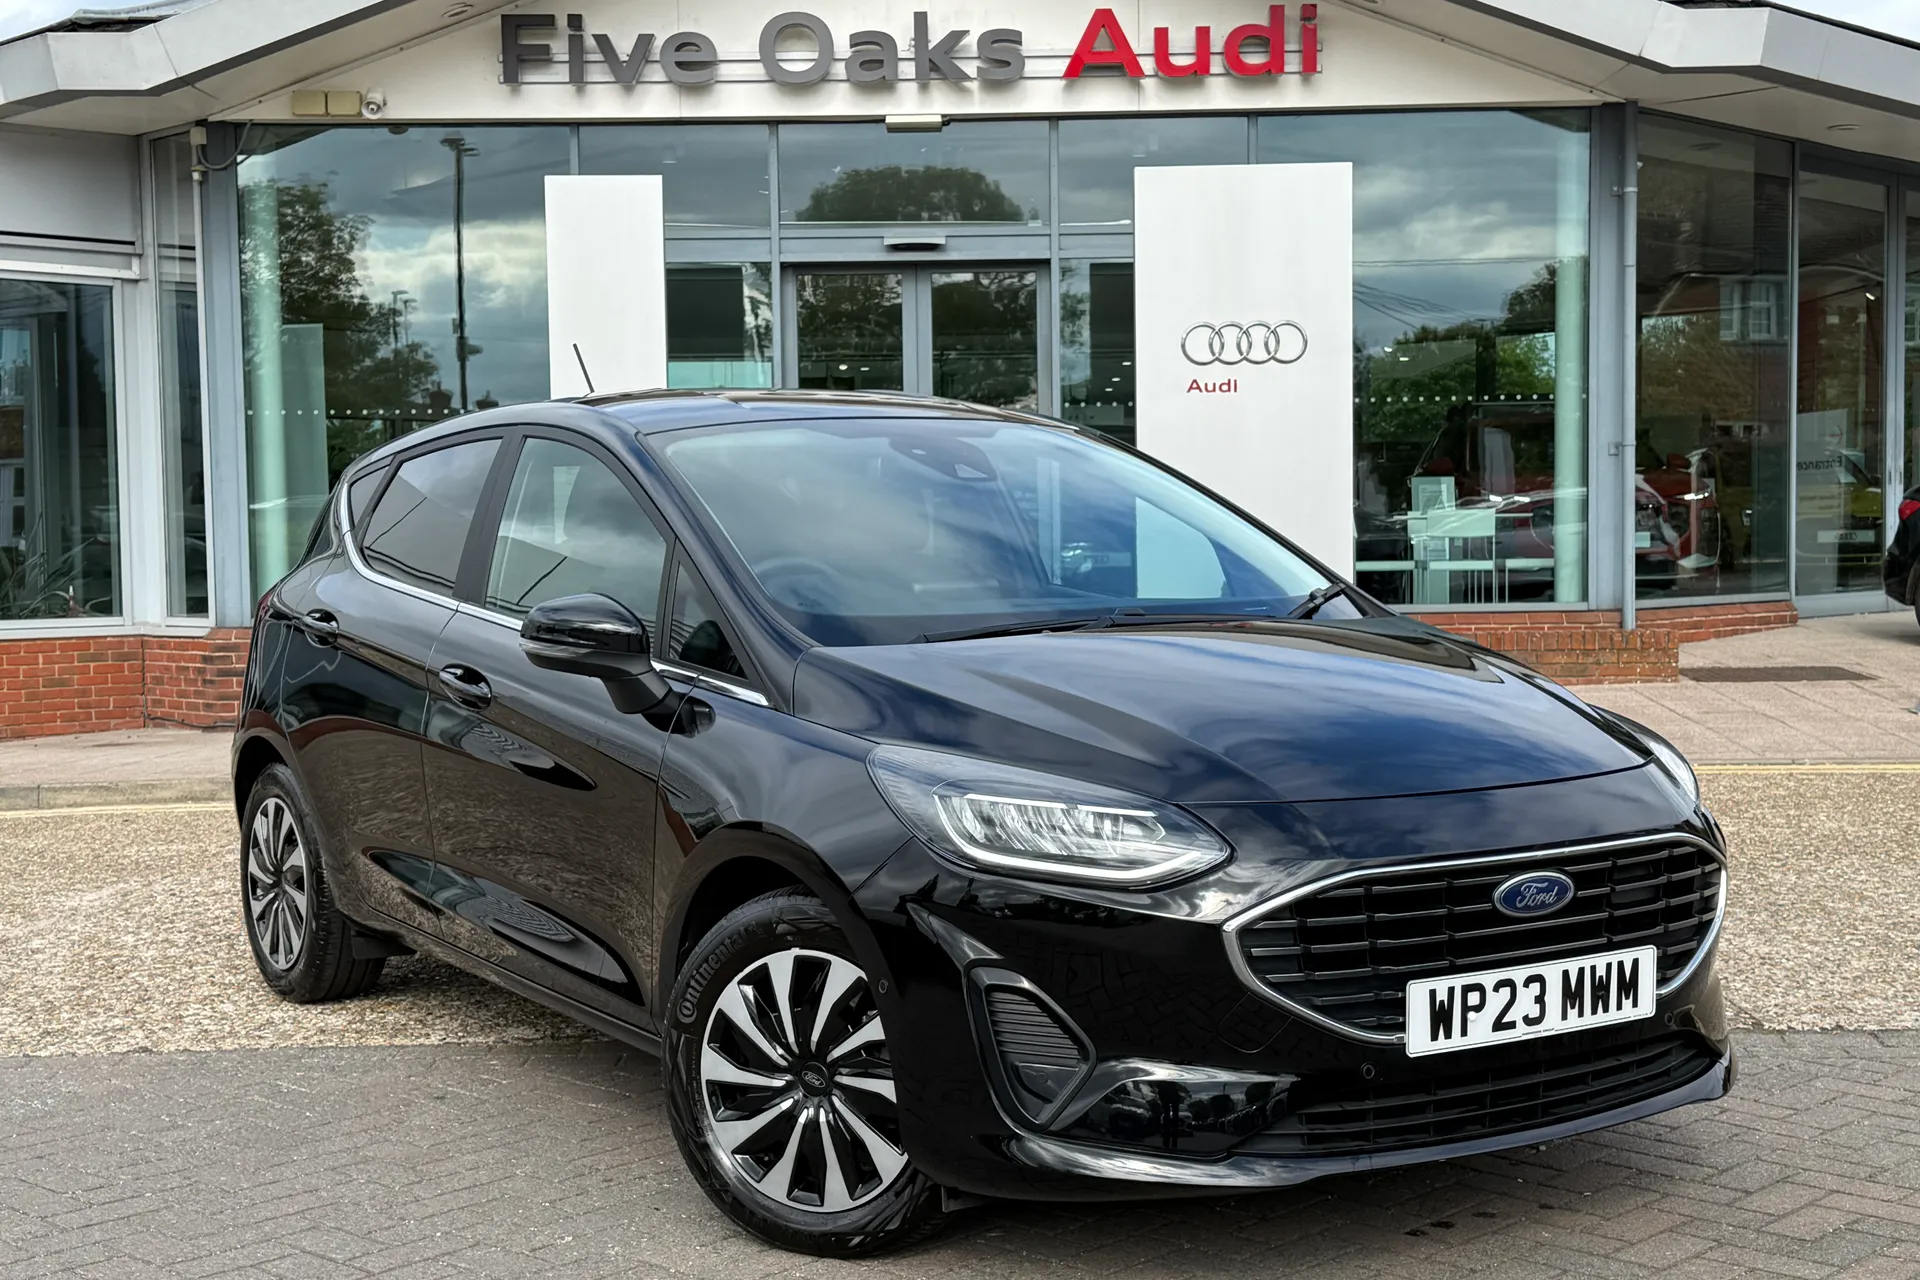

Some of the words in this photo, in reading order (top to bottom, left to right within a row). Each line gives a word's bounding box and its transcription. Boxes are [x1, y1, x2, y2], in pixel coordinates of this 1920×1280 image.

[501, 13, 718, 87] Five
[758, 10, 1026, 87] Oaks
[1062, 3, 1318, 79] Audi
[1186, 378, 1238, 394] Audi
[1515, 881, 1559, 908] Ford
[676, 926, 750, 1024] Continental
[1428, 973, 1547, 1043] WP23
[1560, 957, 1640, 1022] MWM
